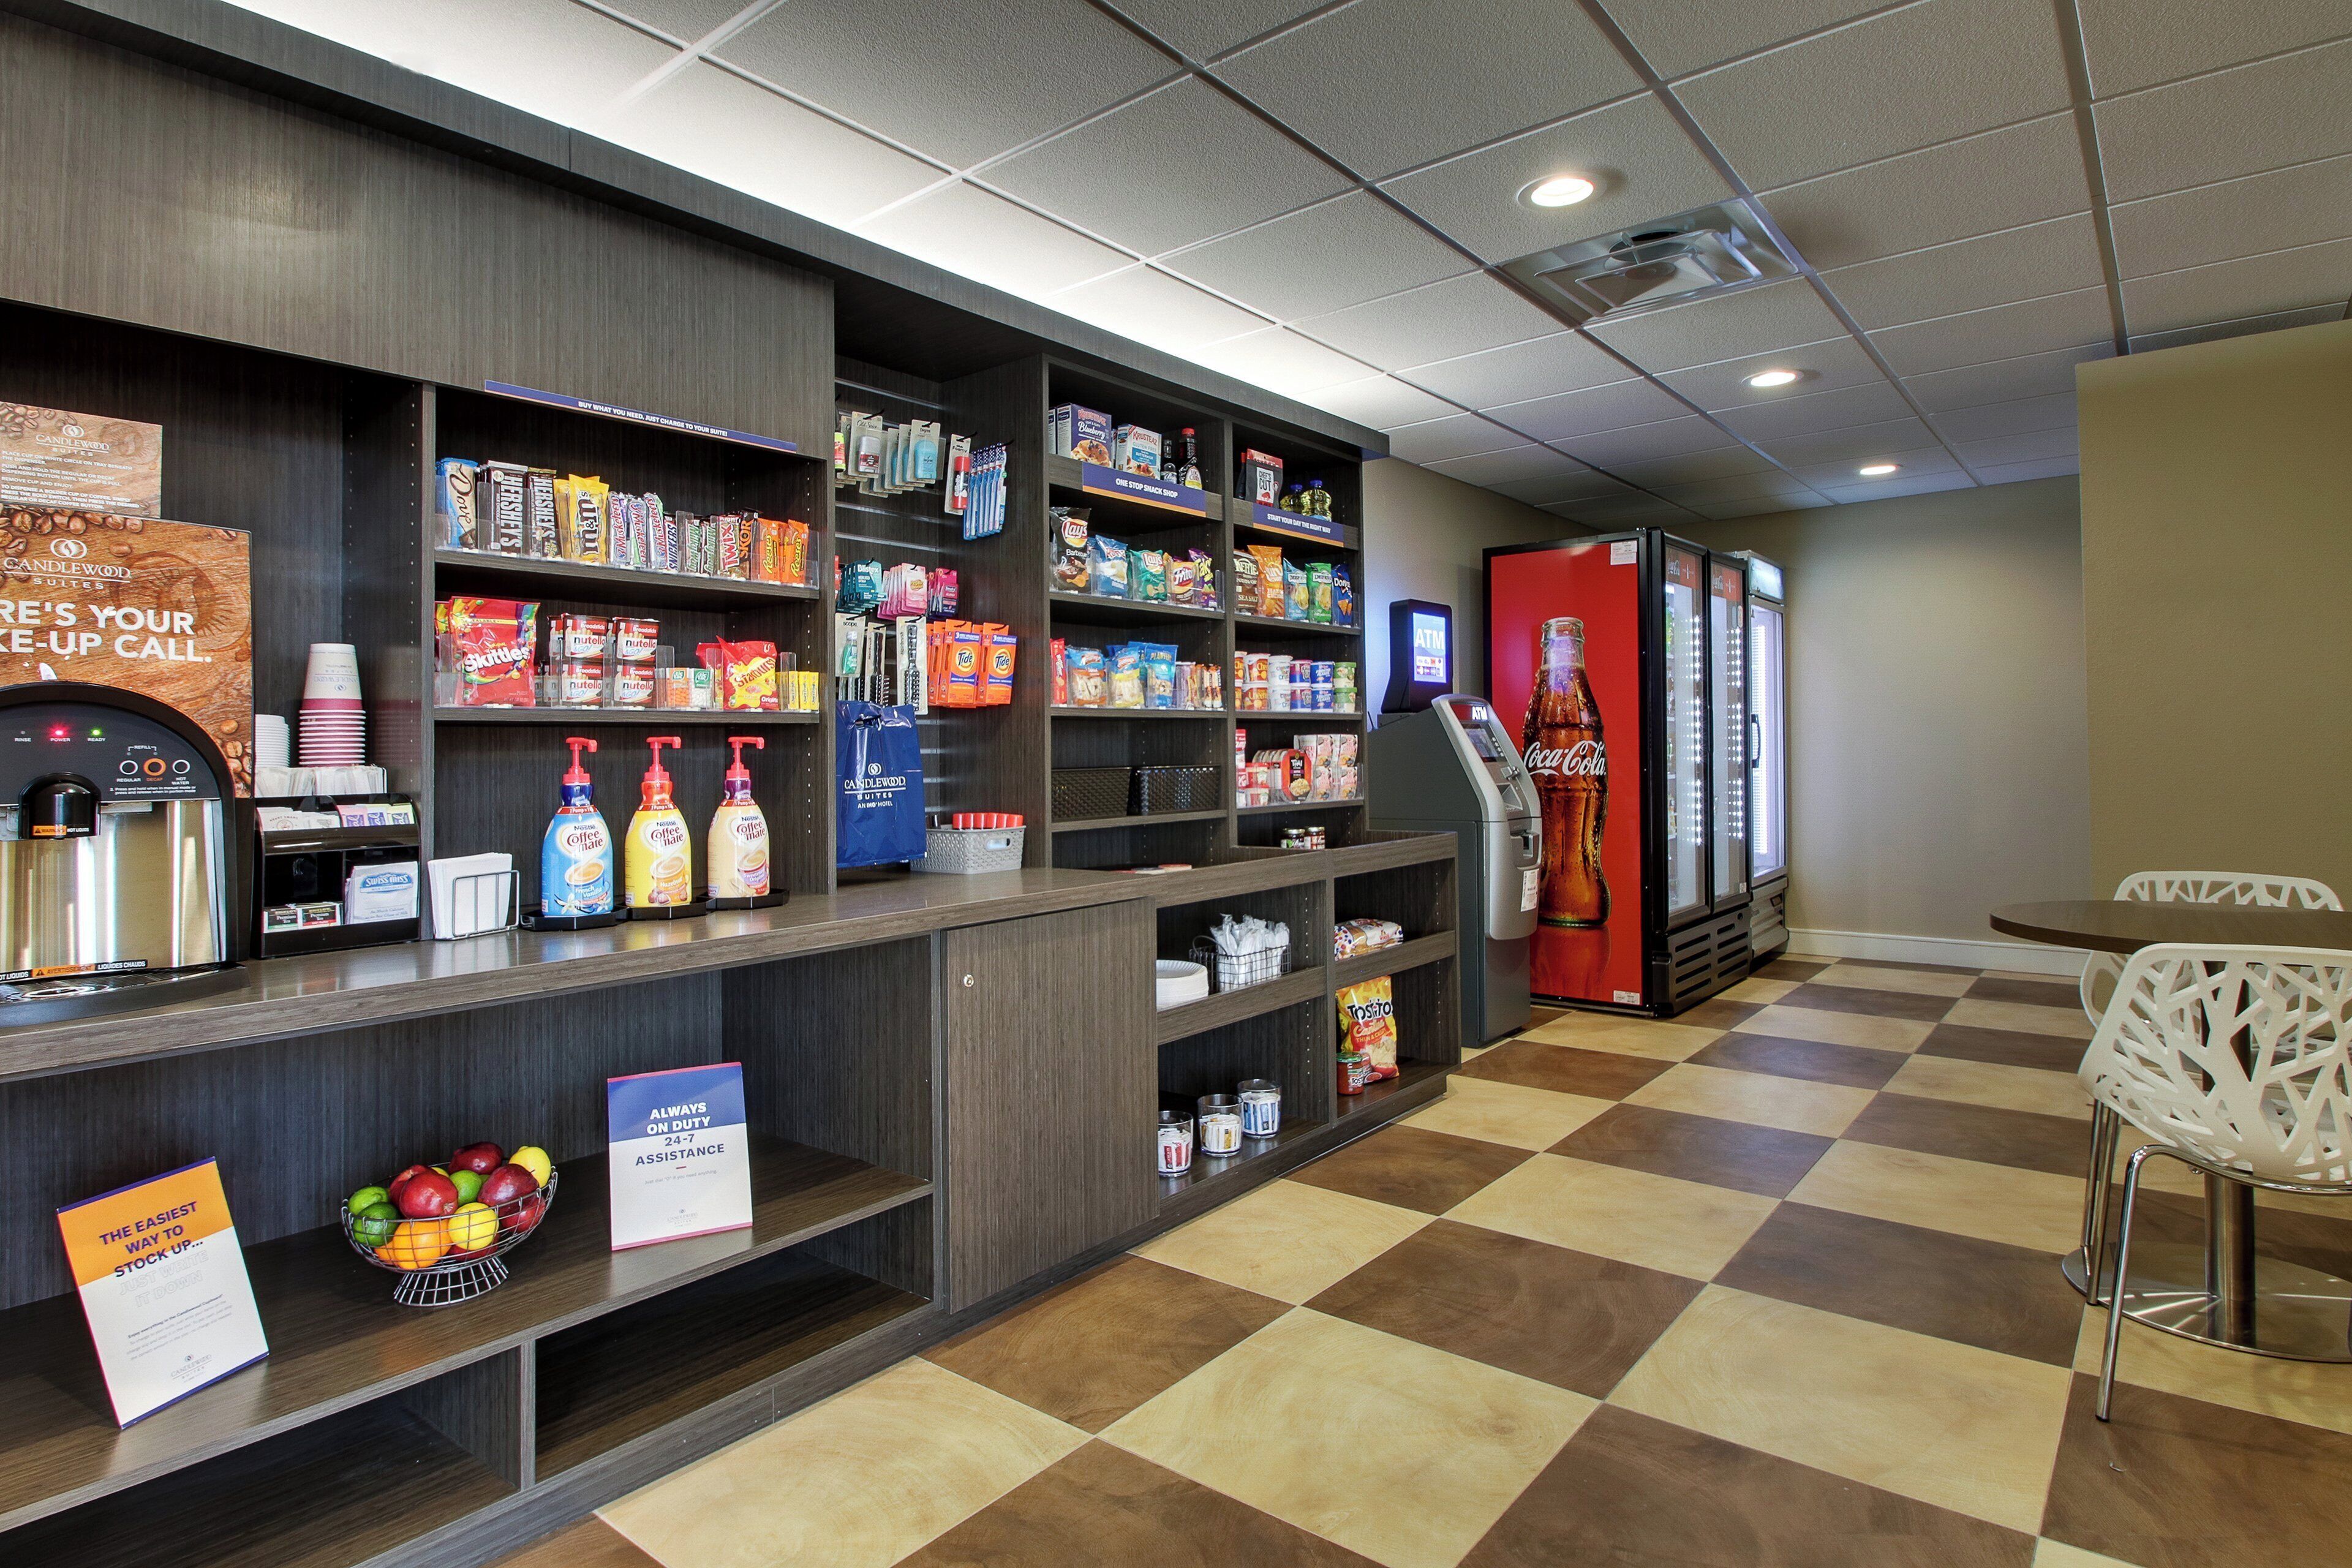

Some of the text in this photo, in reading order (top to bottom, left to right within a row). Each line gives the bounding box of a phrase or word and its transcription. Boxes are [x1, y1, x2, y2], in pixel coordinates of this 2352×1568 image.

[593, 404, 611, 413] WHAT
[627, 412, 644, 420] NEED.
[660, 418, 684, 428] CHARGE
[1078, 421, 1106, 439] Blueberry
[1133, 431, 1158, 446] KRUSTEAZ
[36, 435, 109, 451] CANDLEWOOD
[1259, 470, 1272, 480] CHEF'S
[1116, 478, 1178, 499] ONE STOP SNACK SHOP
[1259, 478, 1271, 491] CUT
[500, 476, 523, 548] HERSHEY'S
[534, 477, 556, 538] HERSHEY'S
[740, 520, 753, 558] SKOR
[1066, 522, 1088, 539] Lay's
[668, 524, 678, 571] SNICKERS
[721, 524, 739, 571] TWIX
[4, 557, 130, 579] CANDLEWOOD
[1144, 554, 1163, 565] Lay's
[858, 564, 879, 573] Blistex
[34, 578, 104, 590] SUITES
[88, 604, 195, 635] YOUR
[574, 636, 606, 645] nutella
[625, 639, 656, 648] nutella
[1415, 628, 1444, 650] ATM
[114, 635, 212, 663] CALL.
[464, 647, 530, 673] Skittles
[959, 652, 973, 666] Tide
[995, 656, 1009, 668] Tide
[570, 680, 601, 689] nutella
[623, 680, 654, 690] nutella
[1472, 706, 1488, 720] ATM
[1524, 740, 1606, 776] Coca-Cola
[845, 776, 906, 790] CANDLEWOOD
[858, 792, 892, 801] SUITES
[745, 828, 766, 841] mate
[578, 838, 603, 853] mate
[660, 878, 683, 888] Hazelnut
[47, 965, 92, 974] AVERTISSEMENT
[650, 1102, 707, 1120] ALWAYS
[647, 1116, 711, 1135] ON DUTY
[665, 1134, 695, 1147] 24-7
[636, 1144, 725, 1166] ASSISTANCE
[99, 1201, 197, 1245] THE EASIEST
[125, 1225, 184, 1254] WAY TO
[115, 1239, 203, 1278] STOCK UP...
[120, 1250, 209, 1295] JUST WRITE
[135, 1270, 203, 1307] IT DOWN
